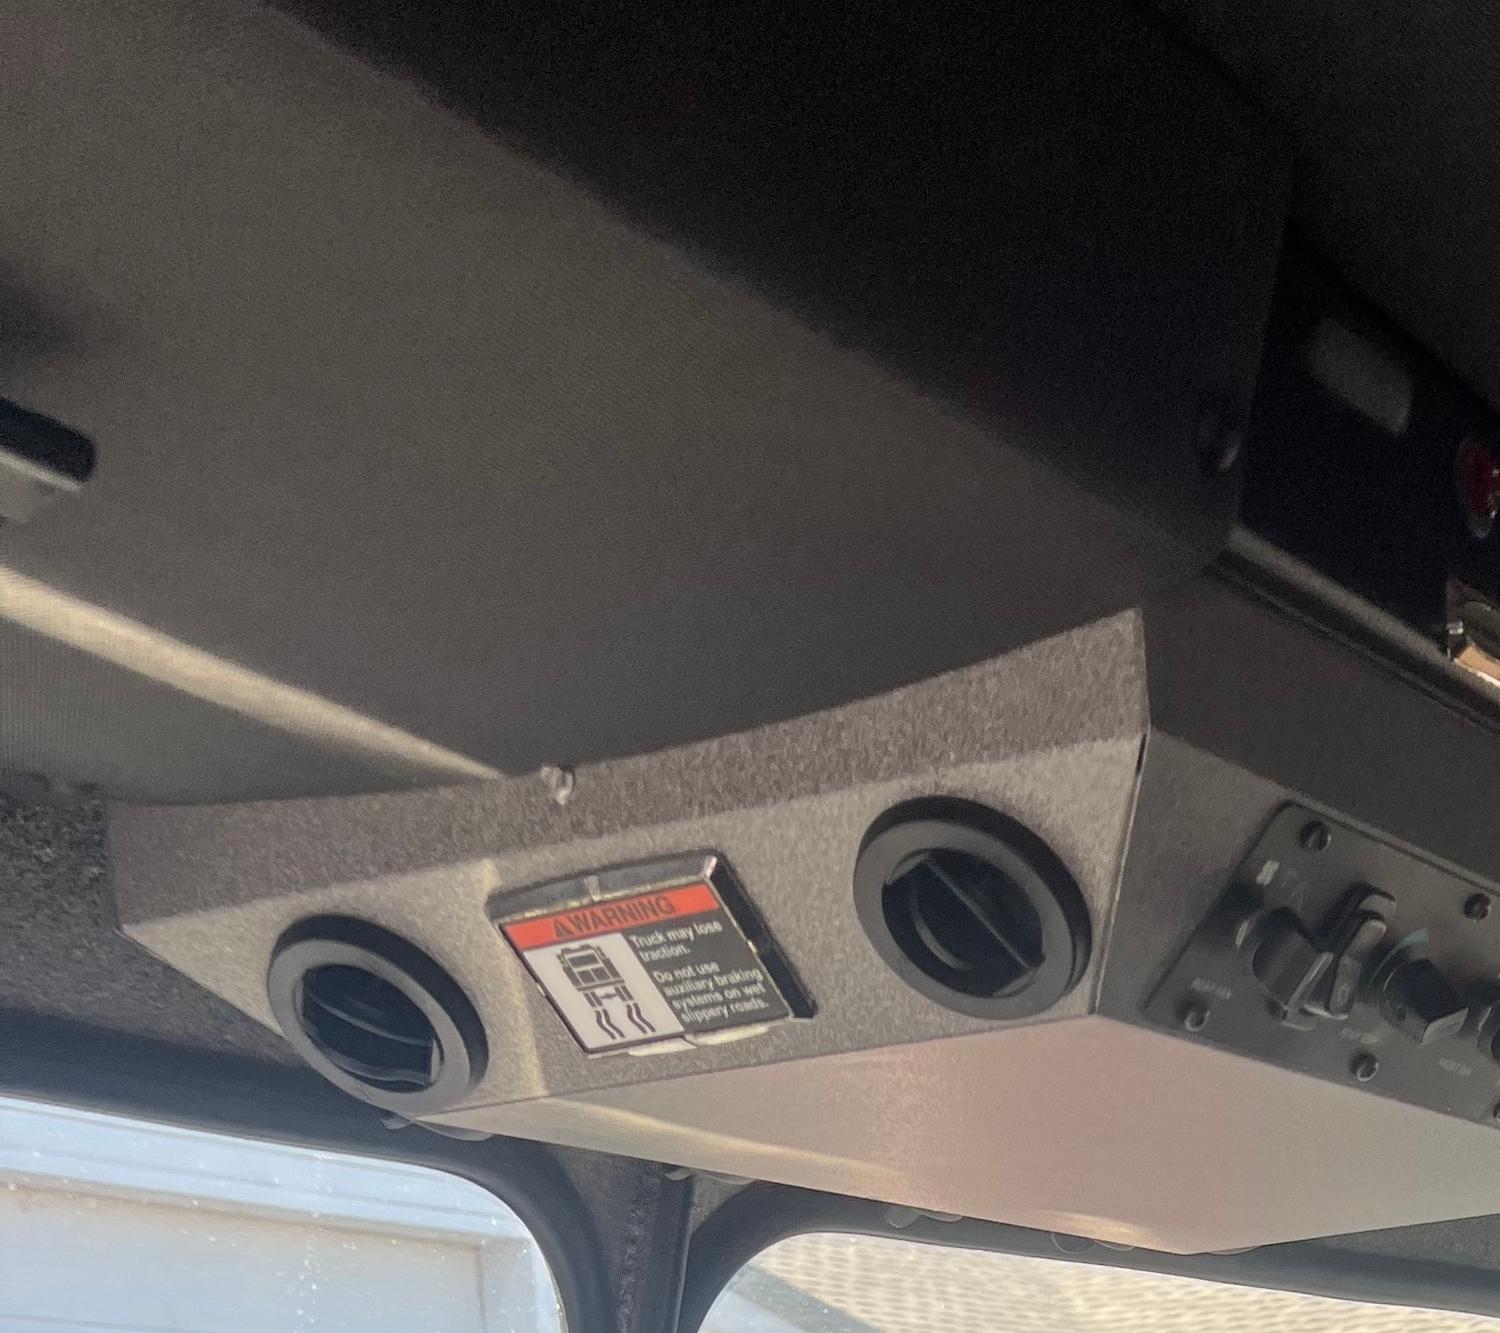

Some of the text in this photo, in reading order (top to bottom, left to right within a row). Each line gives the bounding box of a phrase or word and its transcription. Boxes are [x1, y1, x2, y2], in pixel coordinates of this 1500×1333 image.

[567, 896, 675, 932] WARNING
[630, 920, 723, 948] Truck may lose
[640, 944, 691, 962] traction.
[653, 962, 719, 984] Do not use
[664, 967, 764, 998] auxiliary braking
[672, 982, 765, 1012] systems on wet
[681, 1000, 769, 1024] slippery roads.
